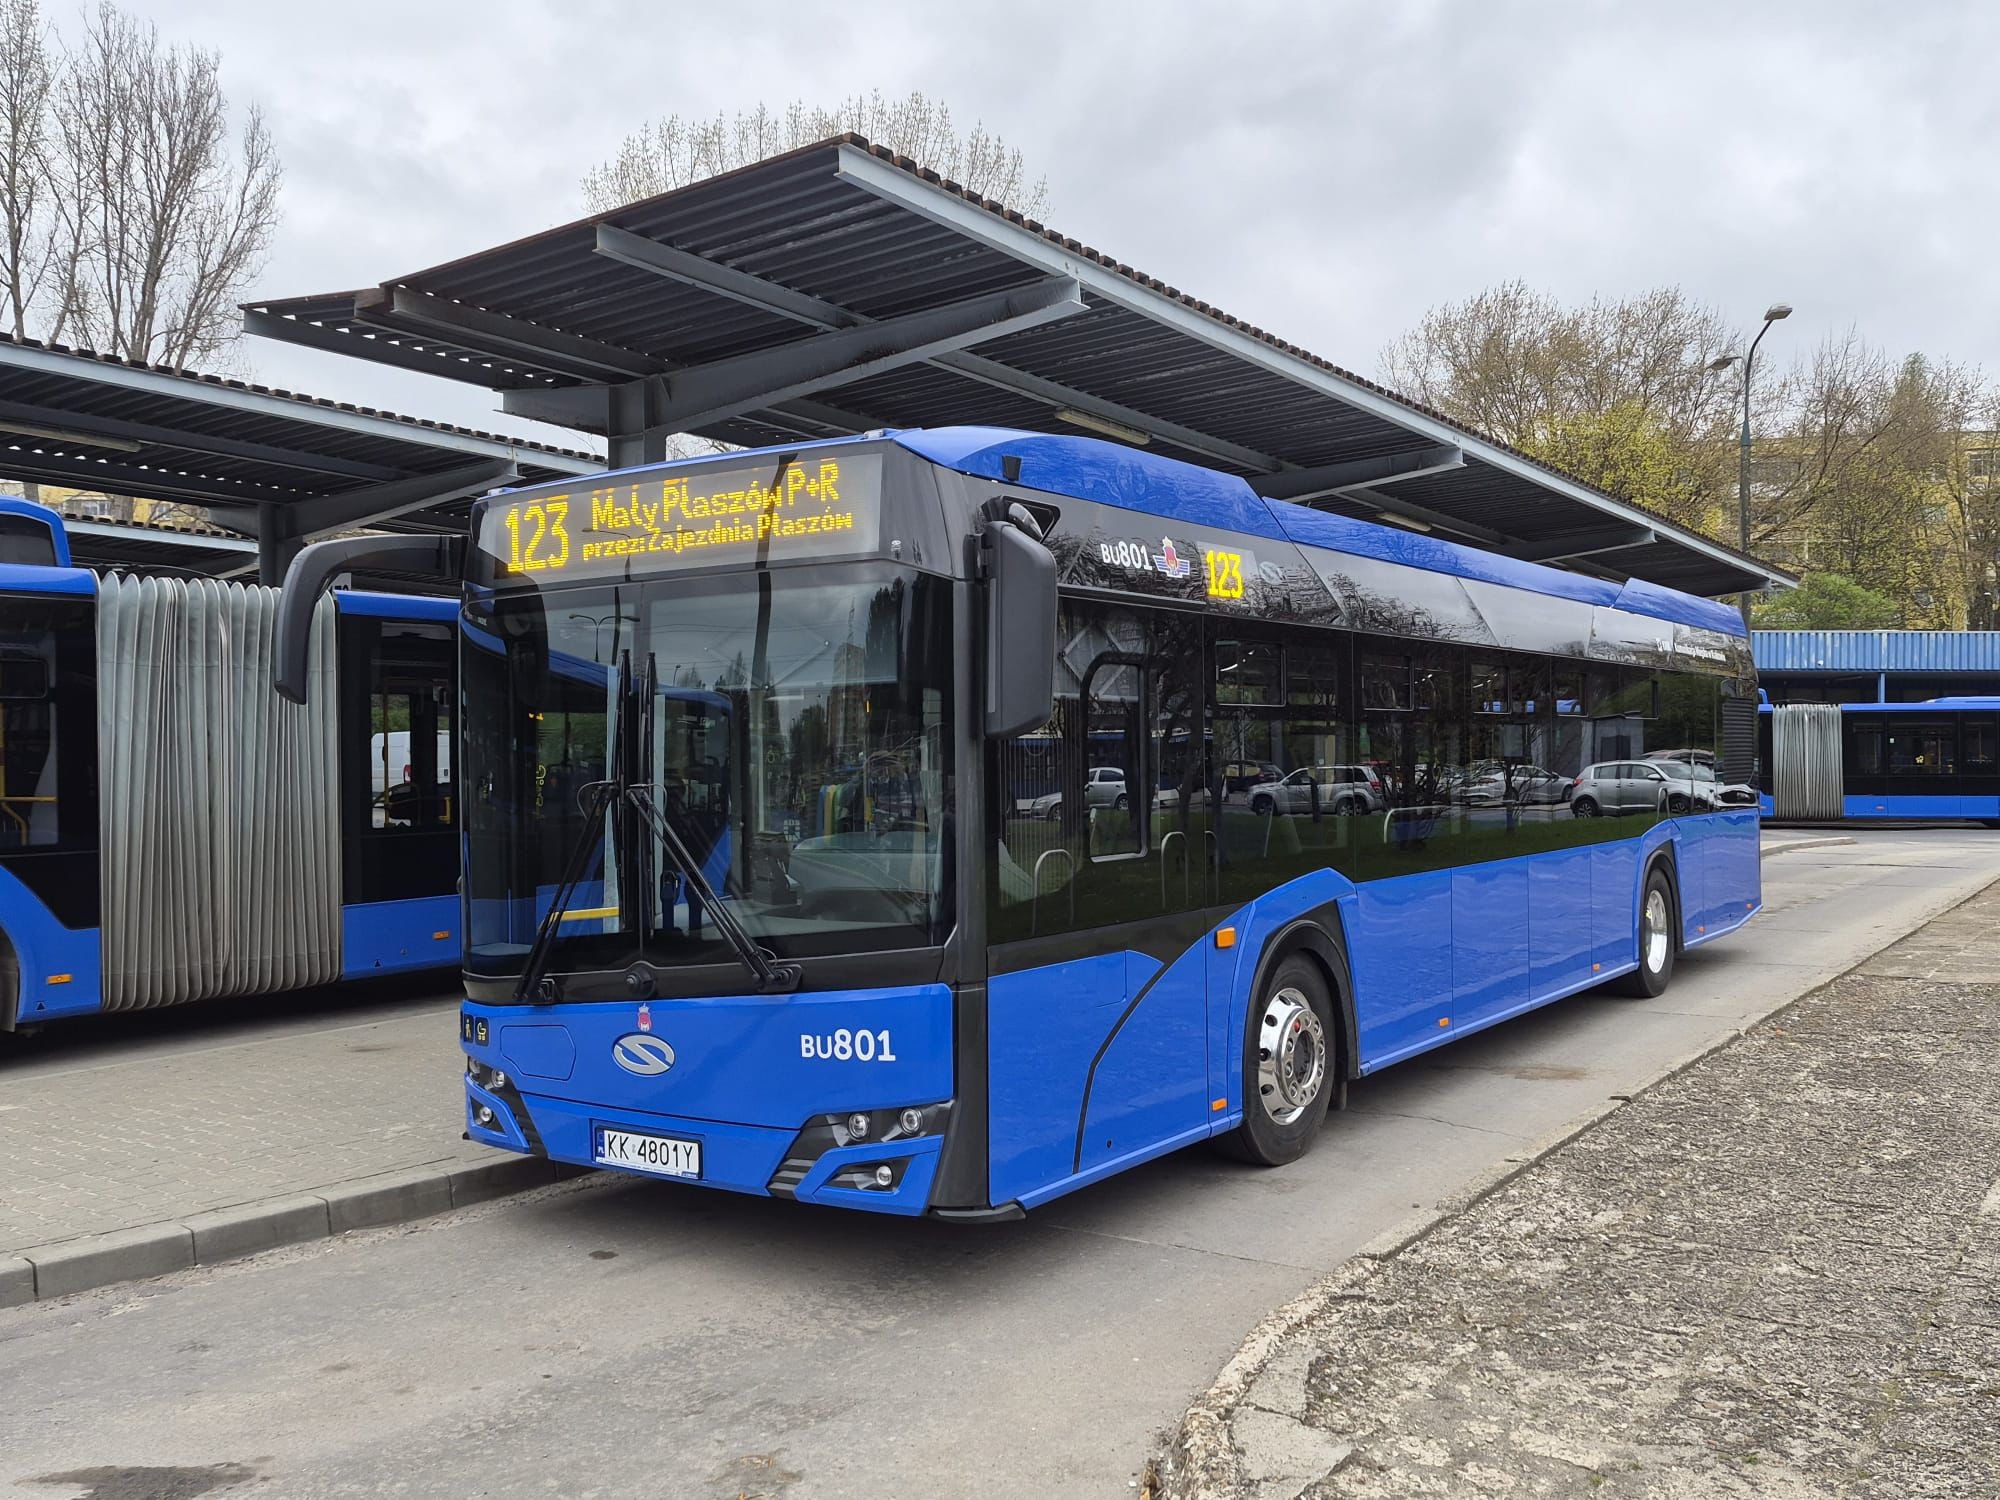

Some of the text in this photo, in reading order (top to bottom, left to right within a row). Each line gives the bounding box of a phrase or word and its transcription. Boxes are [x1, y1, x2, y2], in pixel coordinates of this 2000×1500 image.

[663, 480, 782, 522] Płaszów
[787, 463, 839, 505] P+R
[505, 503, 569, 573] 123
[583, 537, 645, 562] przez:
[648, 517, 754, 554] Zajezdnia
[1100, 541, 1153, 571] BU801
[1205, 549, 1244, 599] 123
[800, 1029, 896, 1062] BU801
[608, 1133, 629, 1160] KK
[637, 1138, 693, 1169] 4801Y
